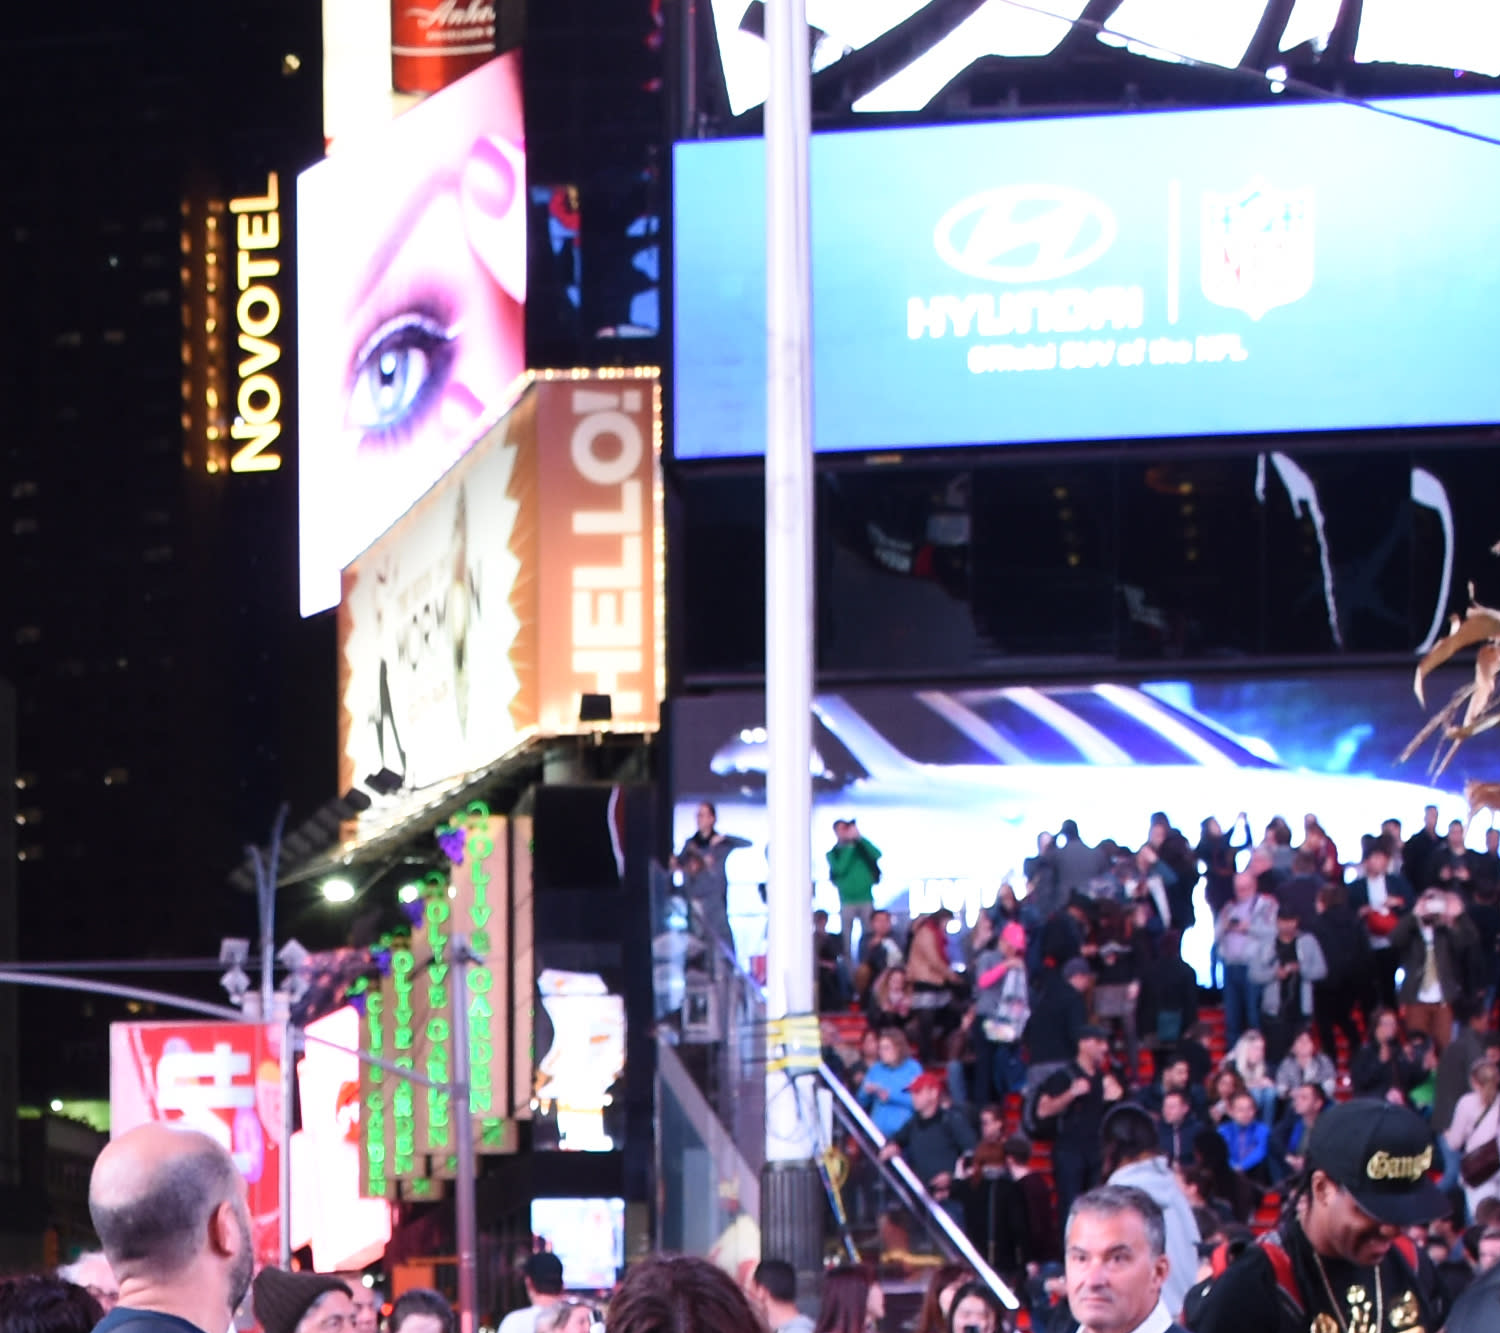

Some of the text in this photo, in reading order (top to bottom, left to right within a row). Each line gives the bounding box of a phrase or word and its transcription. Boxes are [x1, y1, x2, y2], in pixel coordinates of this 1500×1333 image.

[230, 170, 281, 474] NOVOTEL
[906, 285, 1145, 340] HYUNDAI
[571, 388, 643, 716] HELLO!
